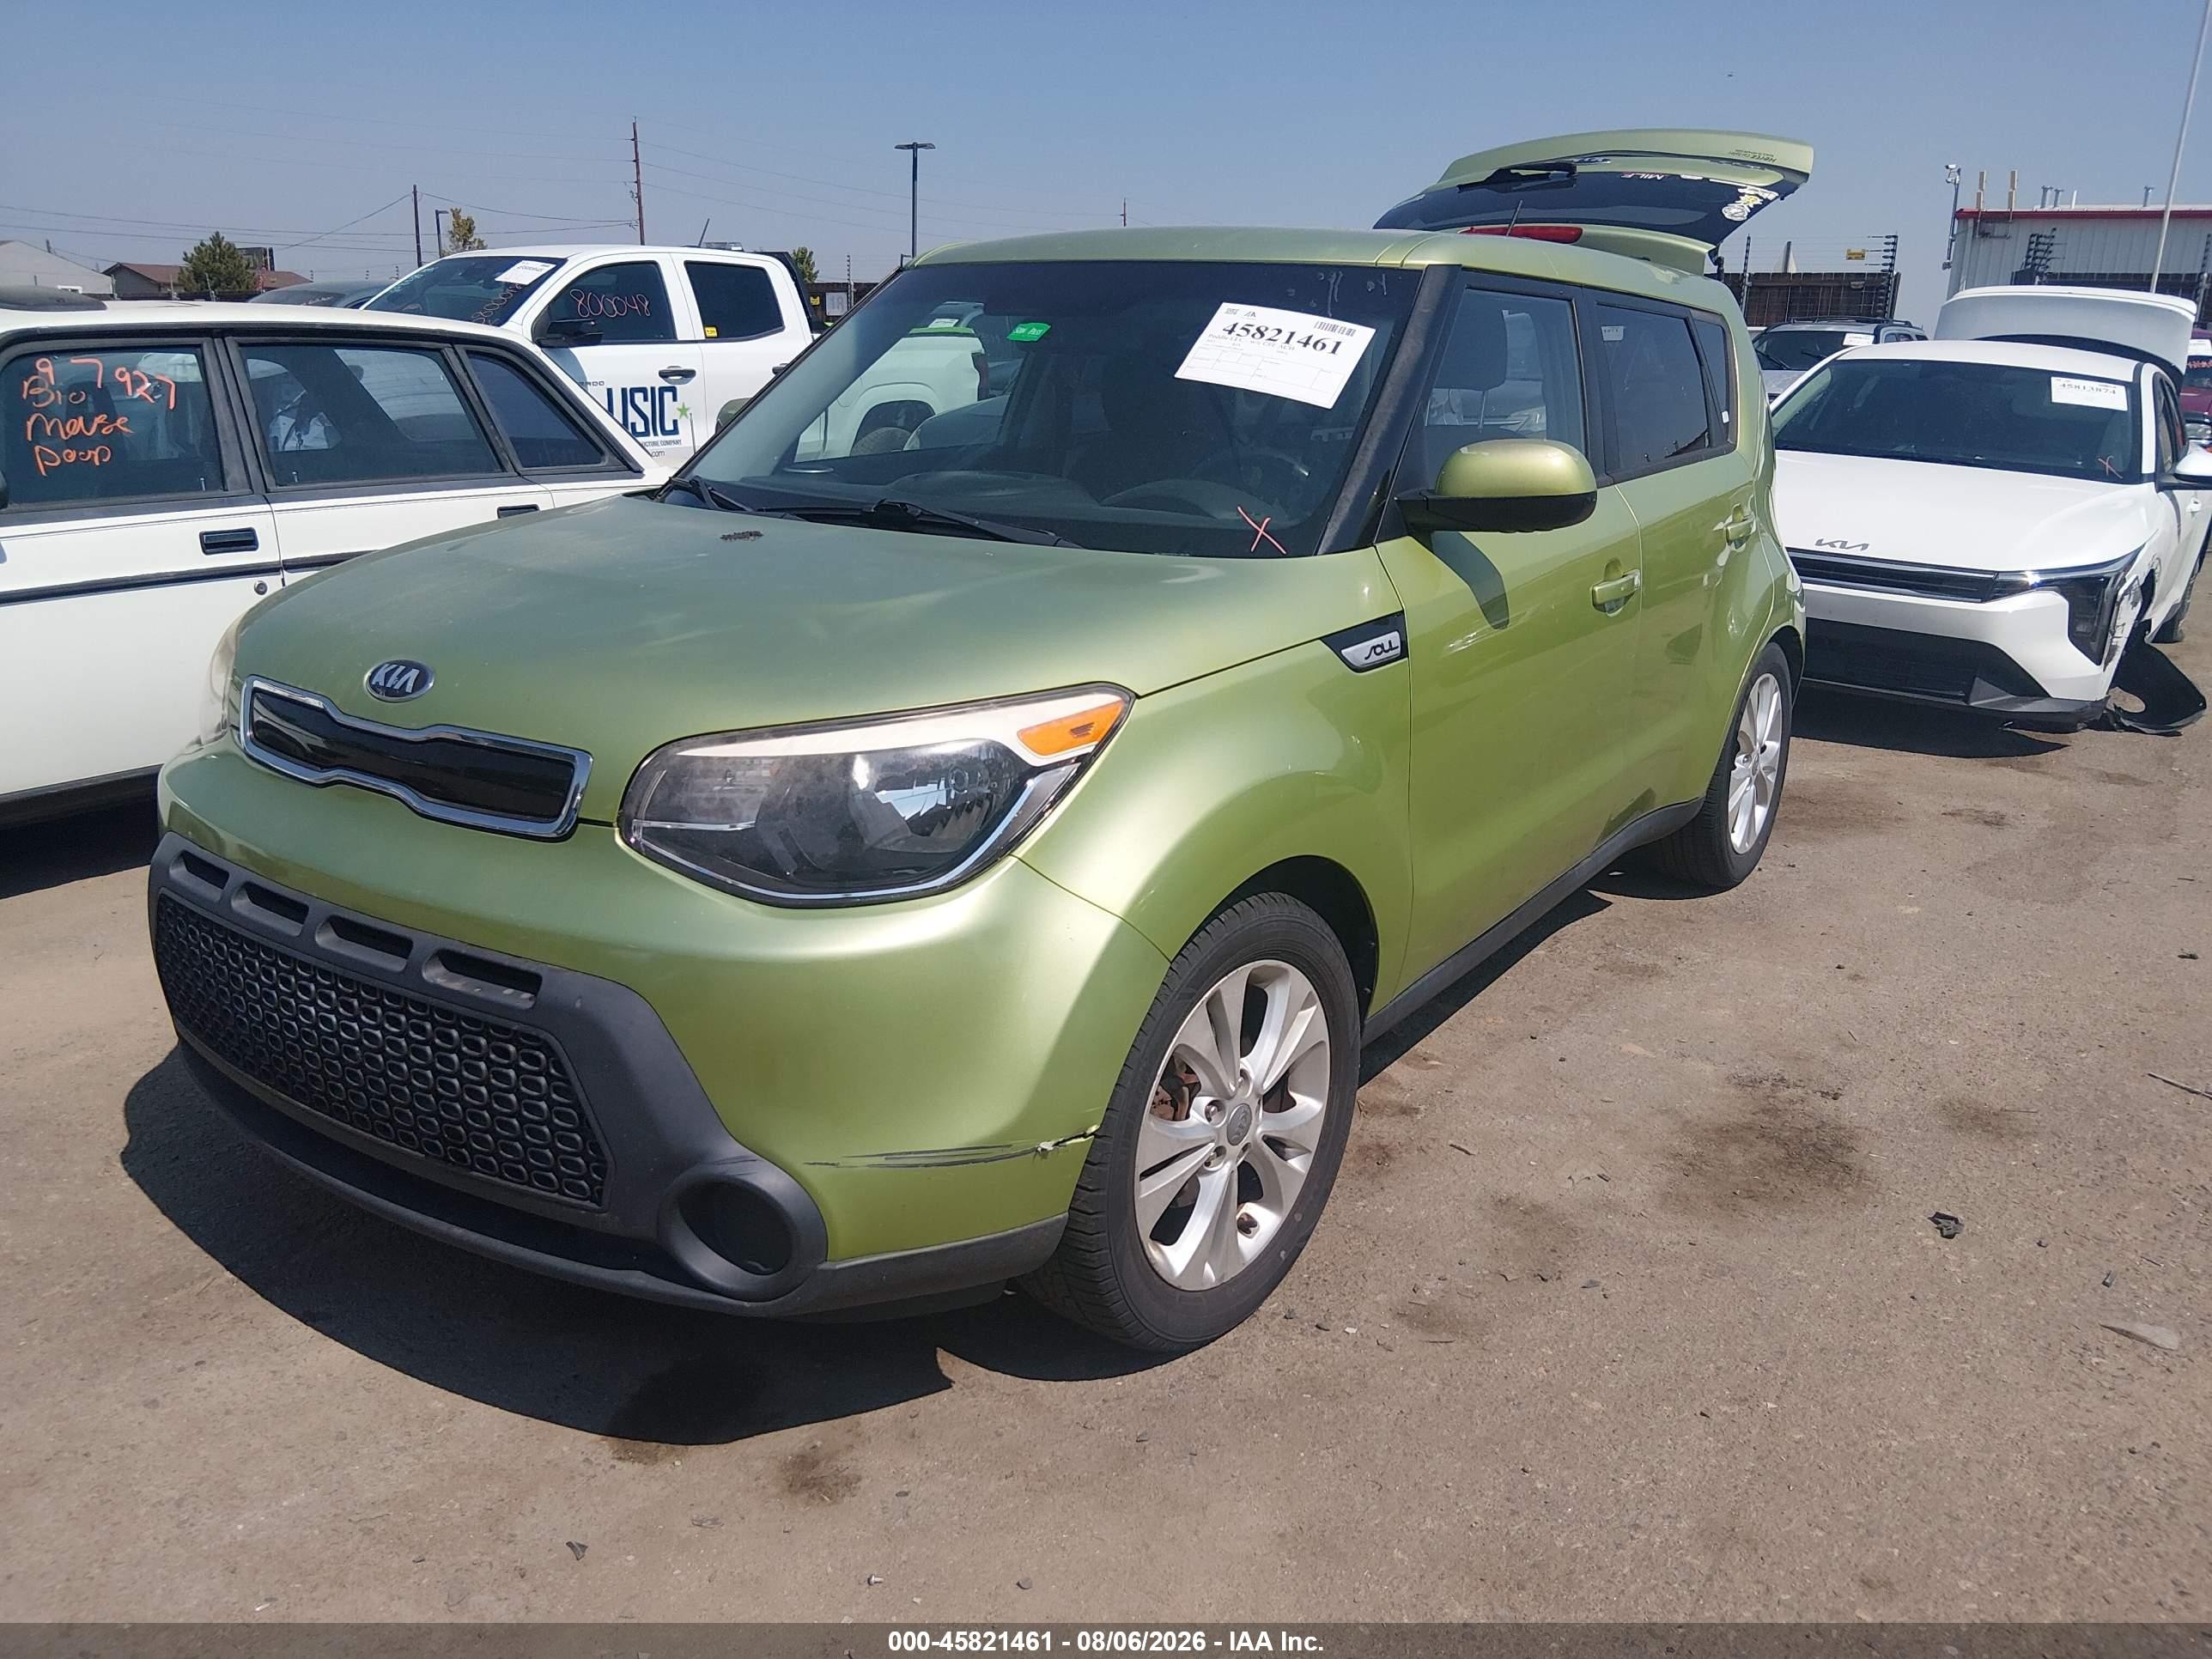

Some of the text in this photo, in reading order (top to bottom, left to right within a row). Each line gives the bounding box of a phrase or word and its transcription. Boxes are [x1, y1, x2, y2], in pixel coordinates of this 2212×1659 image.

[570, 289, 651, 318] 800048
[1223, 322, 1343, 356] 45821461
[372, 664, 420, 693] KIA
